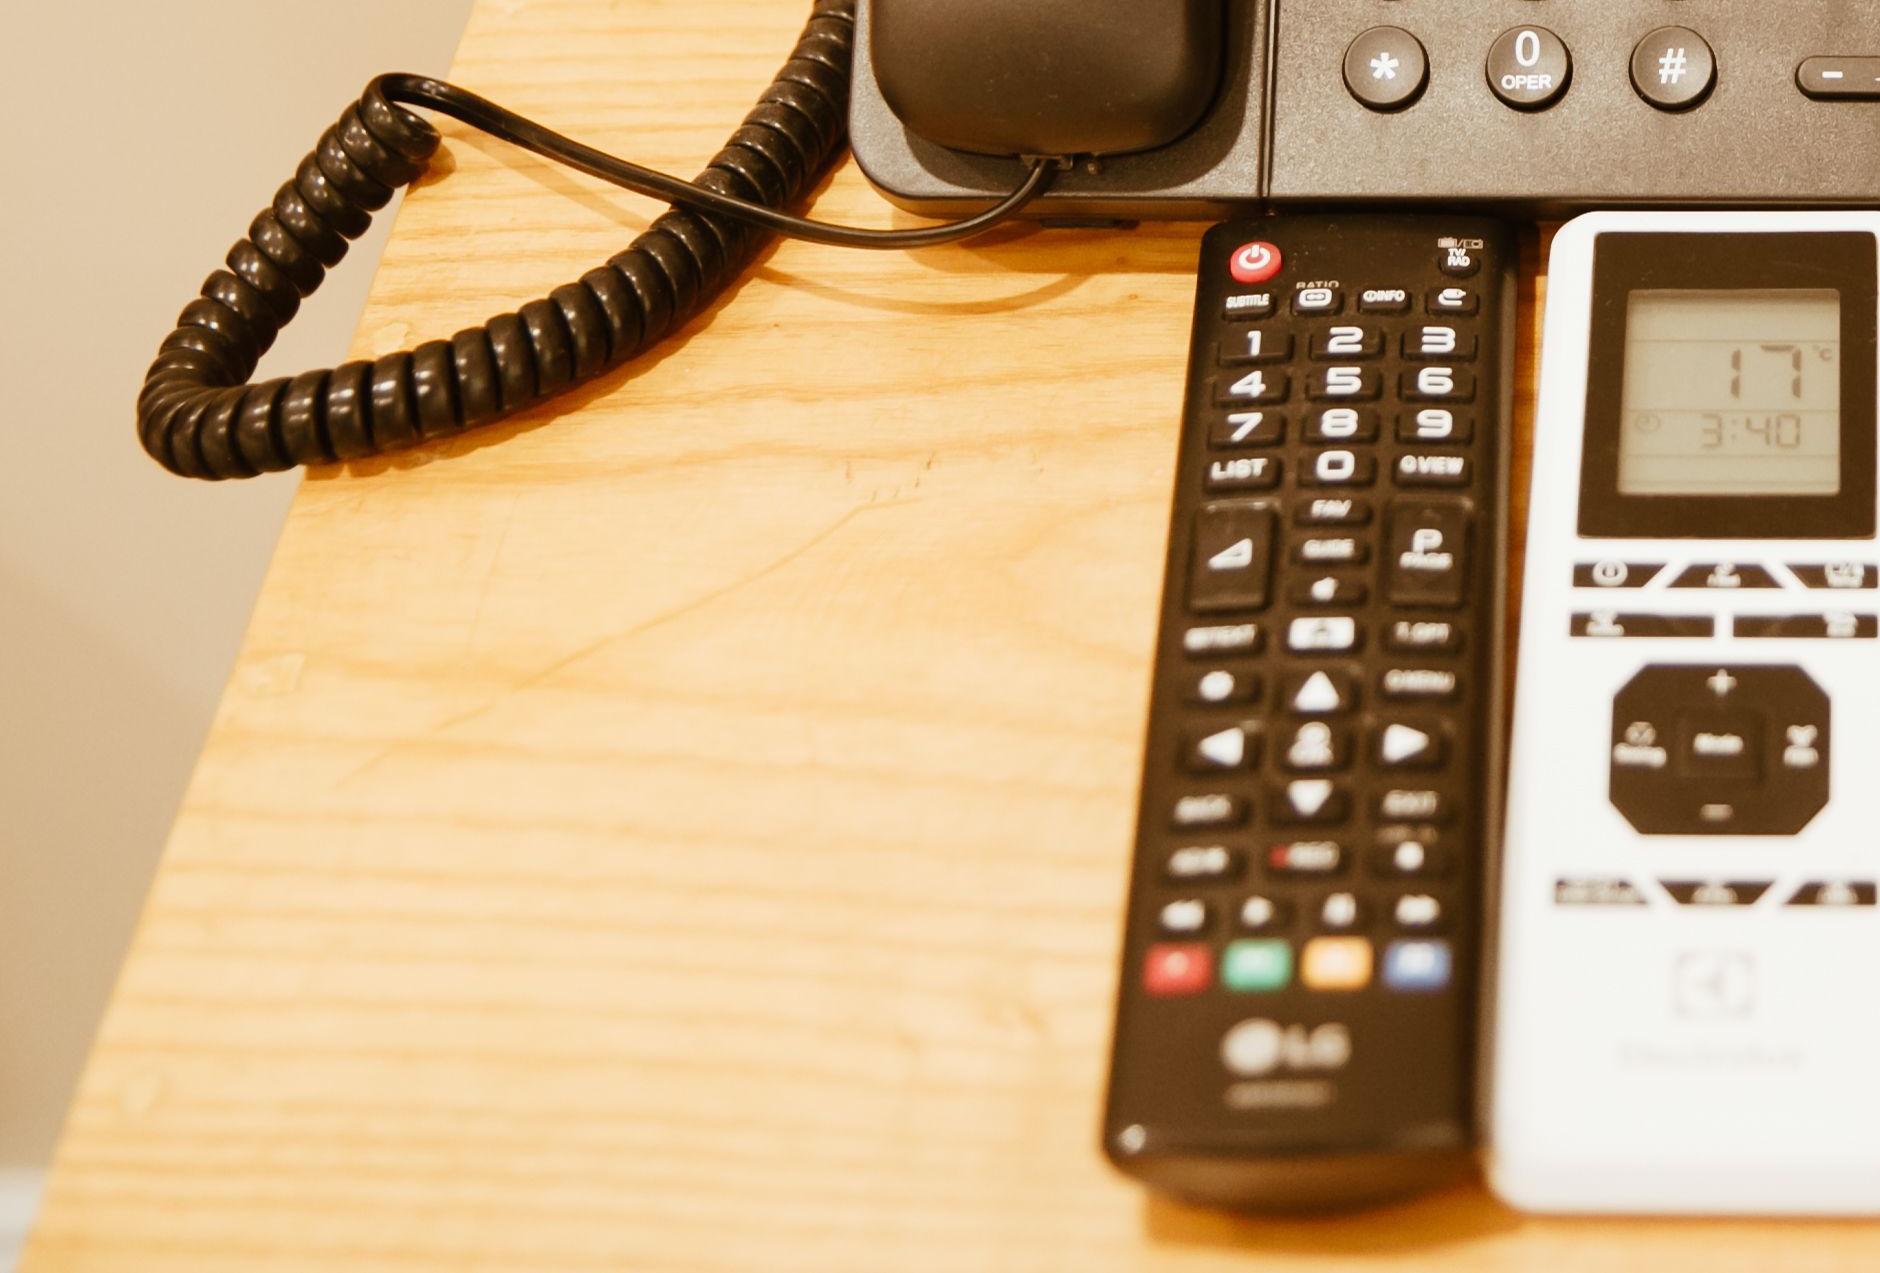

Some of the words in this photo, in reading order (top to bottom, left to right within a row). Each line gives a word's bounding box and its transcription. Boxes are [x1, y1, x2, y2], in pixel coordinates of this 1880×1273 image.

[1515, 30, 1541, 66] 0
[1658, 47, 1687, 85] #
[1501, 74, 1553, 90] OPER
[1226, 293, 1270, 308] SUBTITLE
[1247, 330, 1262, 357] 1
[1327, 326, 1364, 354] 2
[1421, 326, 1456, 353] 3
[1229, 370, 1266, 398] 4
[1326, 366, 1362, 395] 5
[1417, 366, 1454, 395] 6
[1730, 344, 1802, 399] 17
[1227, 412, 1263, 442] 7
[1320, 408, 1359, 438] 8
[1416, 409, 1453, 438] 9
[1701, 412, 1801, 450] 3:40
[1210, 458, 1267, 481] LIST
[1315, 450, 1355, 481] 0
[1413, 528, 1443, 553] P
